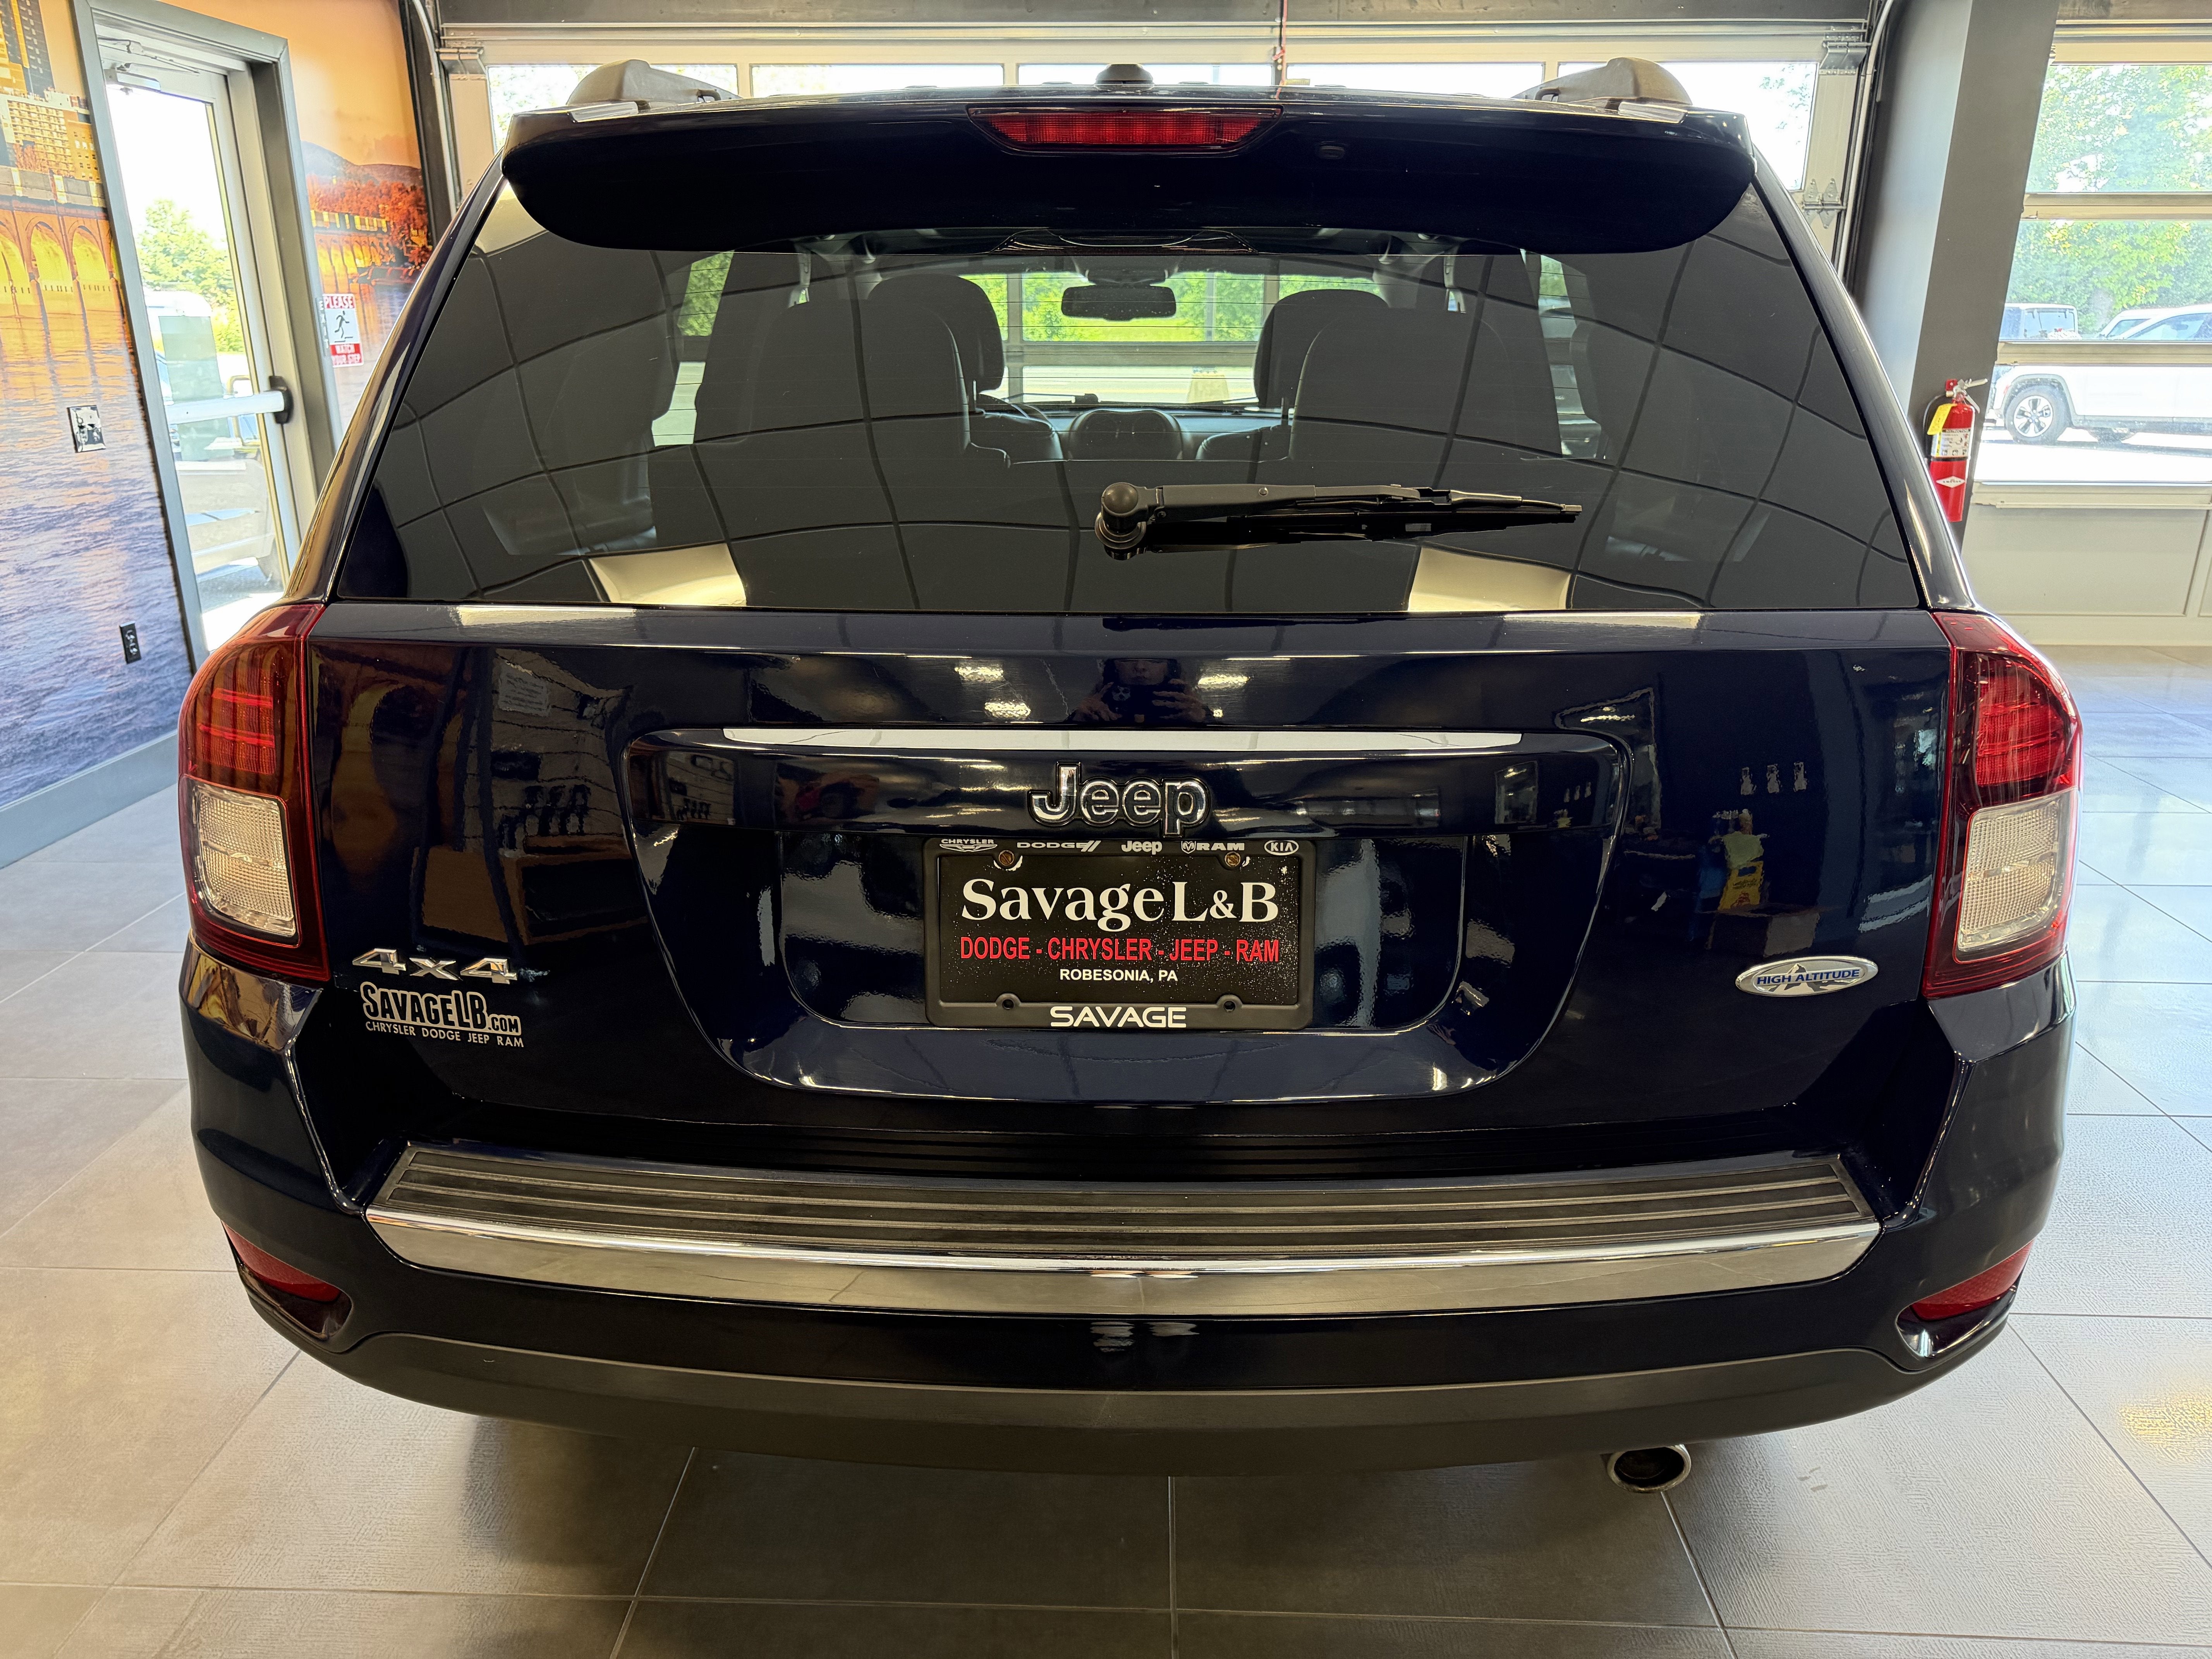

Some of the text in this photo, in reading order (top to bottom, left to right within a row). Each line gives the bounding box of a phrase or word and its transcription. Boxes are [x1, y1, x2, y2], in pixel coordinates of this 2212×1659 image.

[323, 296, 355, 309] PLEASE
[1029, 761, 1211, 837] Jeep
[1121, 840, 1162, 855] Jeep
[1197, 843, 1245, 851] RAM
[1270, 842, 1293, 852] KIA
[962, 878, 1278, 932] Savage L&B
[961, 937, 1030, 960] DODGE
[1048, 938, 1152, 961] CHRYSLER
[1169, 939, 1219, 961] JEEP
[1236, 939, 1279, 962] RAM
[1060, 969, 1178, 983] ROBESONIA, PA
[1757, 969, 1860, 985] HIGH ALTITUDE
[1051, 1007, 1187, 1028] SAVAGE
[365, 1021, 524, 1048] CHRYSLER DODGE JEEP RAM
